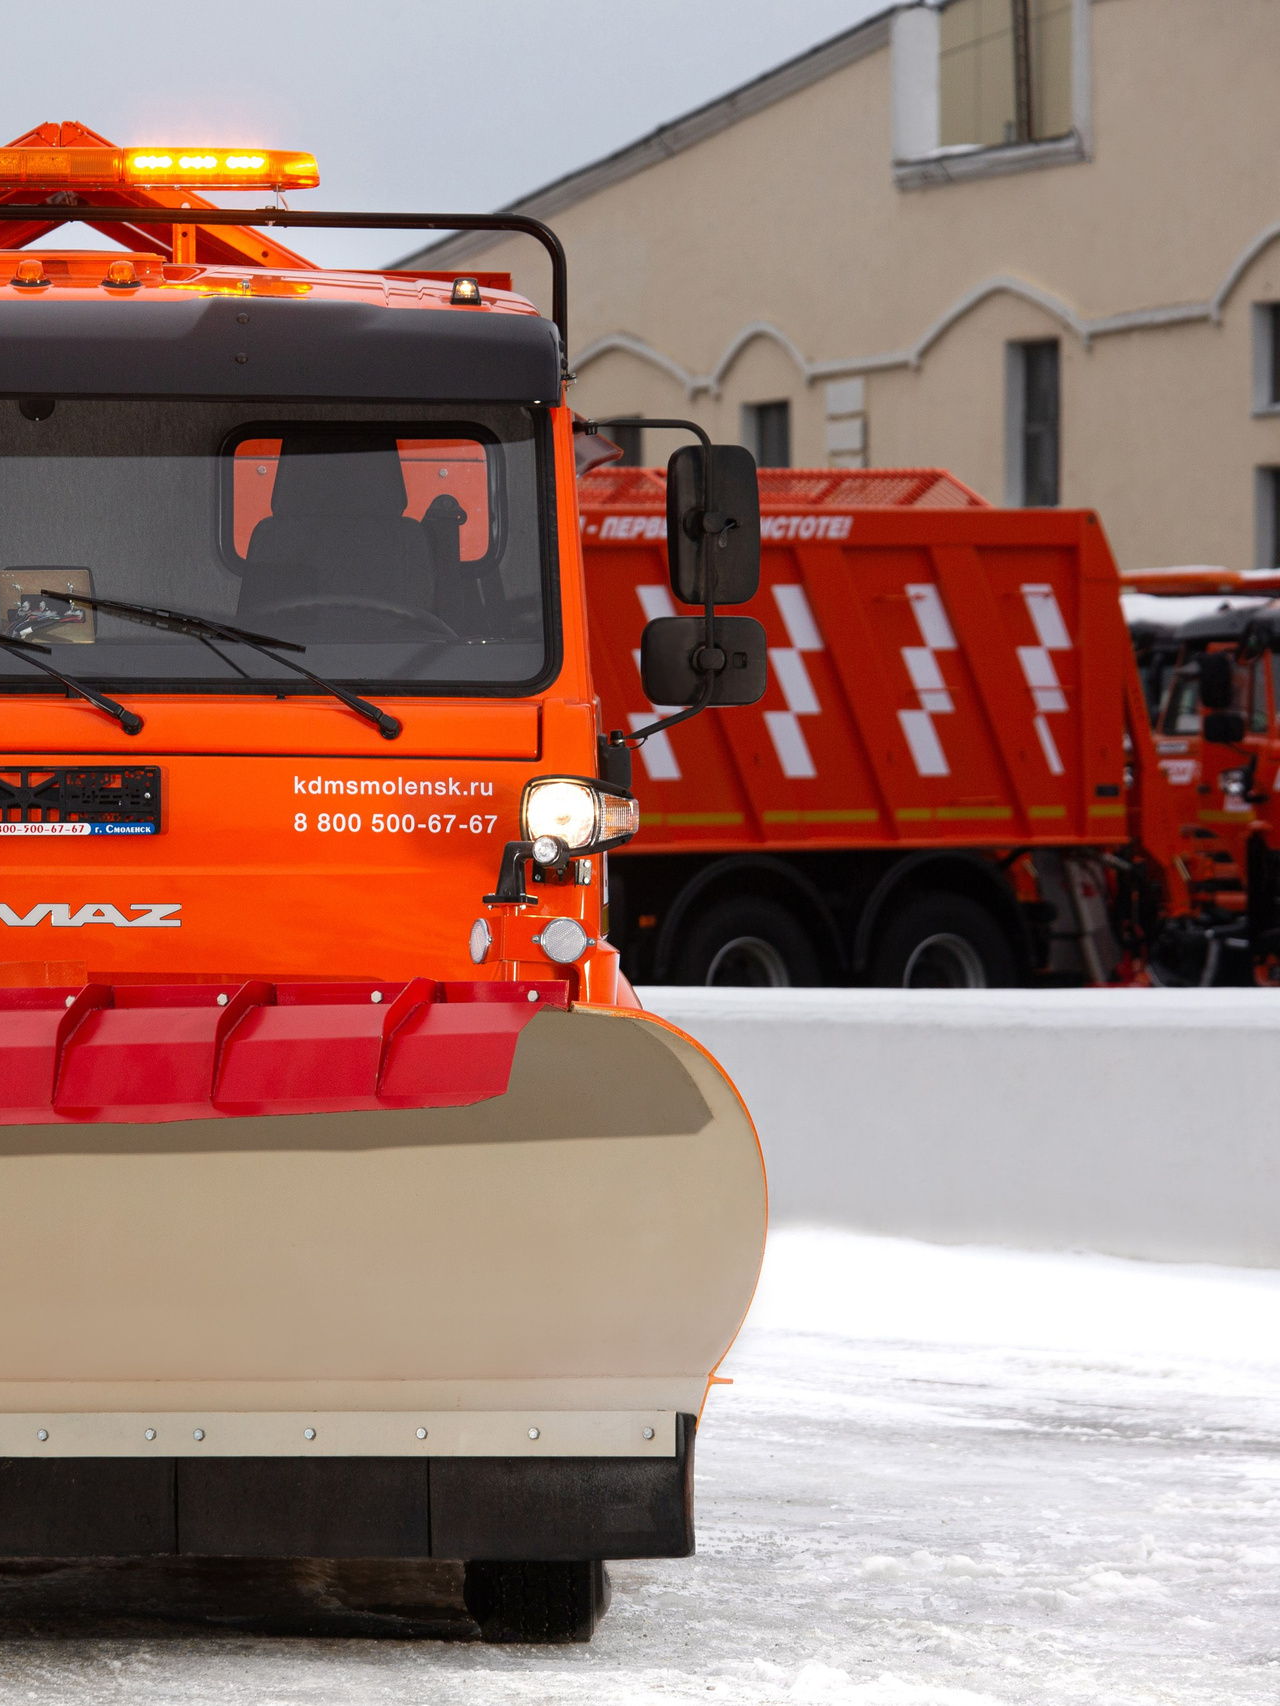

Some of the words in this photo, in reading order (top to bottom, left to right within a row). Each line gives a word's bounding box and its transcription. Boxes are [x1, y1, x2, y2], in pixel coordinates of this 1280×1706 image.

[600, 516, 668, 539] ПЕРВ
[760, 516, 854, 539] ИСТОТЕ!
[293, 776, 493, 796] kdmsmolensk.ru
[293, 813, 308, 832] 8
[317, 813, 362, 833] 800
[371, 814, 498, 834] 500-67-67
